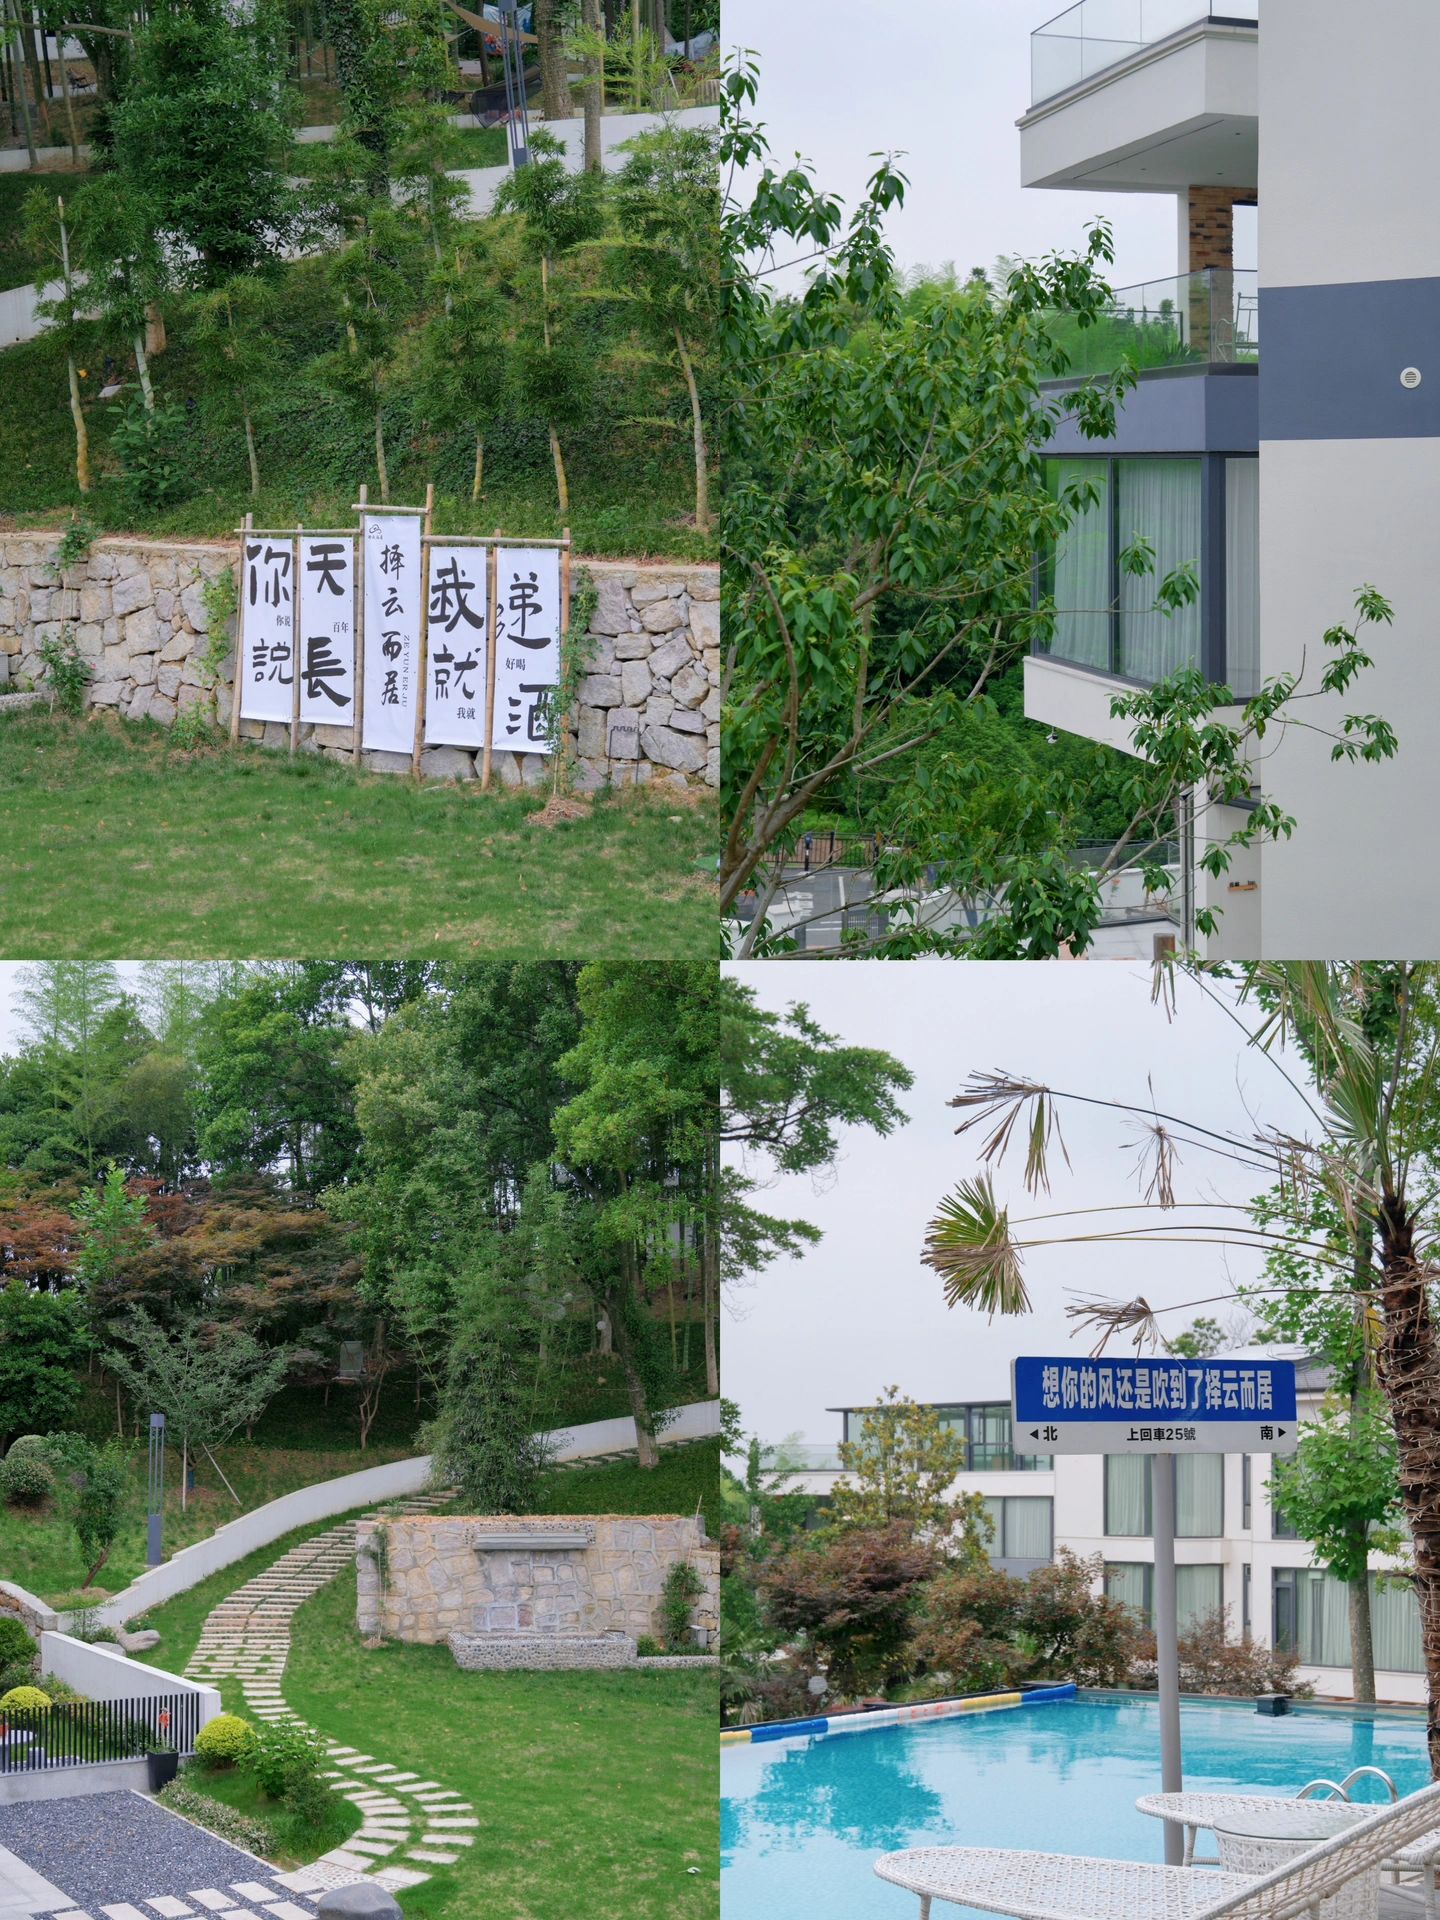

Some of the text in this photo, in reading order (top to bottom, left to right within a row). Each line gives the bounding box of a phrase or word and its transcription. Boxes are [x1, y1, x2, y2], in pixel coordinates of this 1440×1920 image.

[276, 615, 291, 627] 你说
[333, 621, 349, 633] 百年
[505, 657, 526, 671] 好喝
[457, 708, 476, 720] 我就
[1042, 1365, 1273, 1411] 想你的风还是吹到了择云而居
[1043, 1426, 1058, 1441] 北
[1126, 1427, 1196, 1441] 上回車25號
[1260, 1425, 1274, 1441] 南
